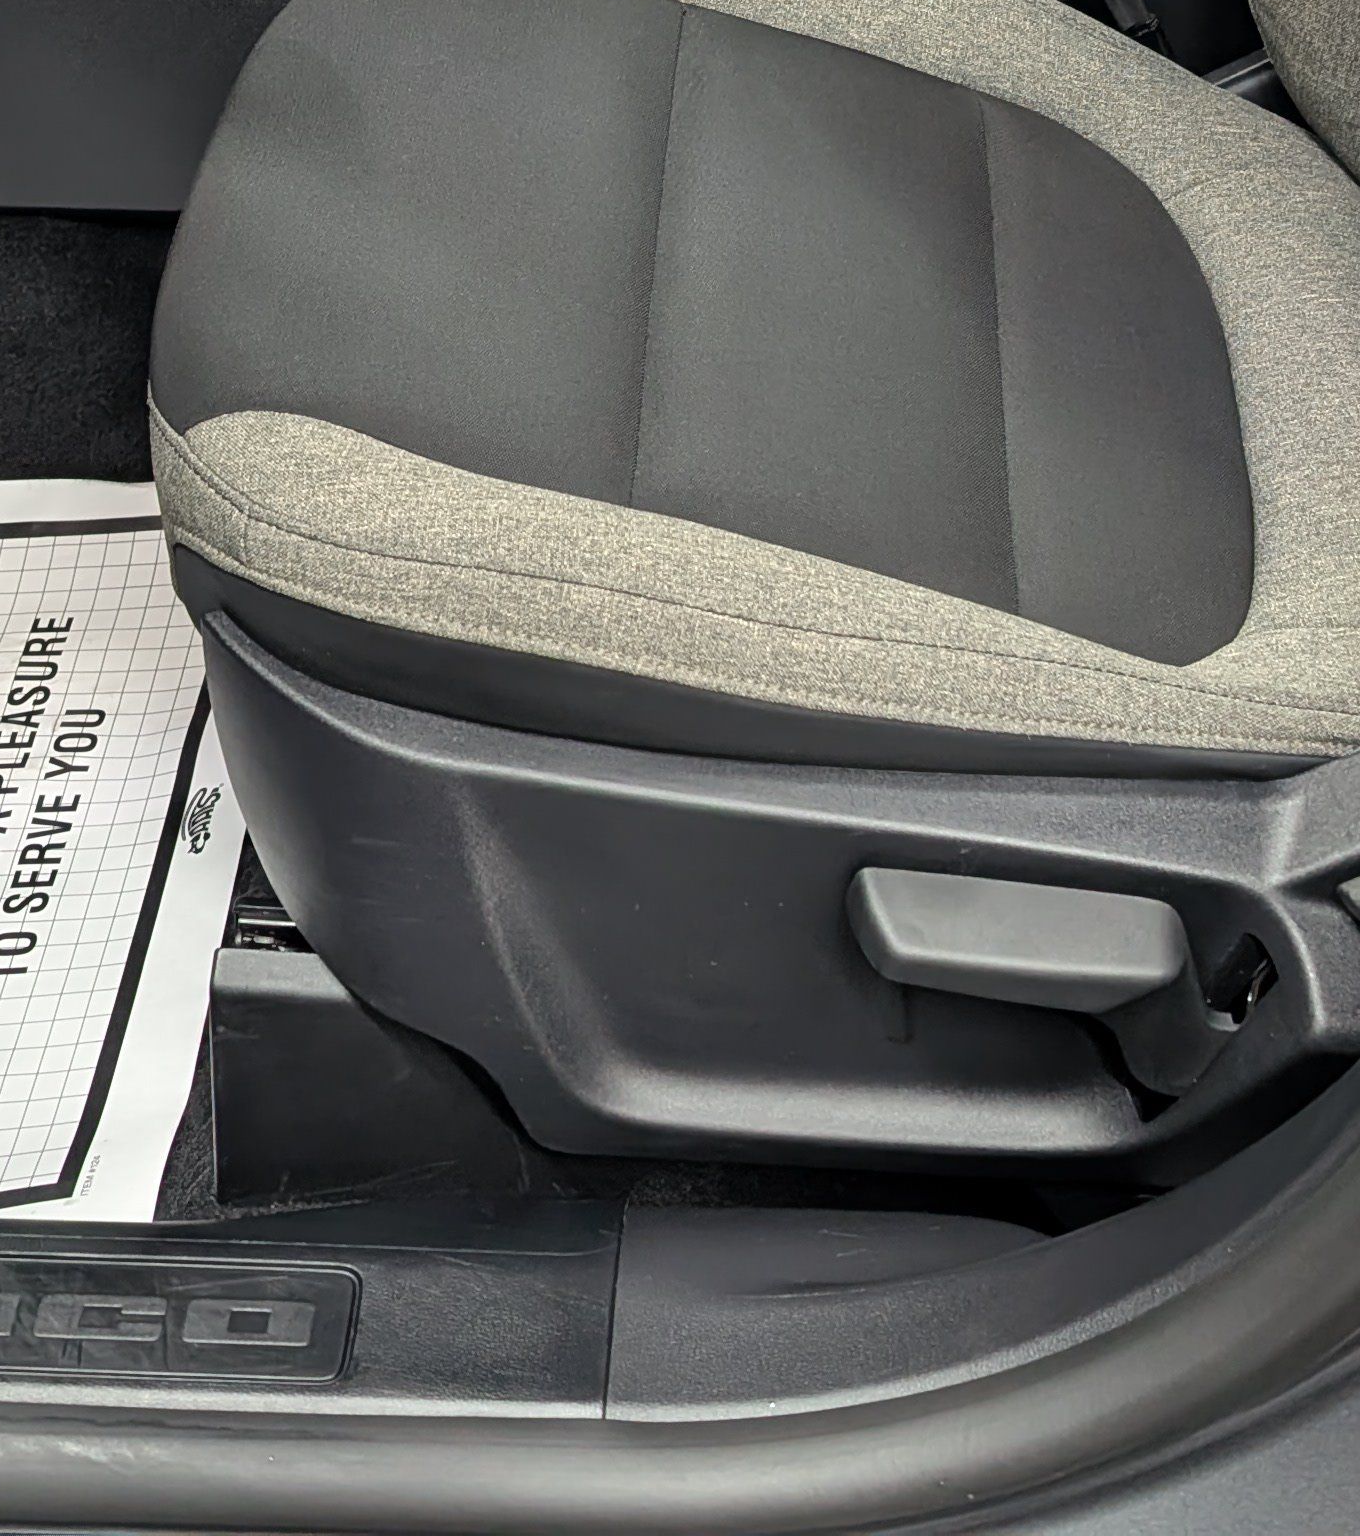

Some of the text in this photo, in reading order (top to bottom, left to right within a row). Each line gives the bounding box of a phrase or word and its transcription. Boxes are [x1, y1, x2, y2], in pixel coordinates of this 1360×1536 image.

[2, 794, 81, 914] SERVE
[43, 709, 106, 780] YOU
[80, 1174, 94, 1197] ITEM
